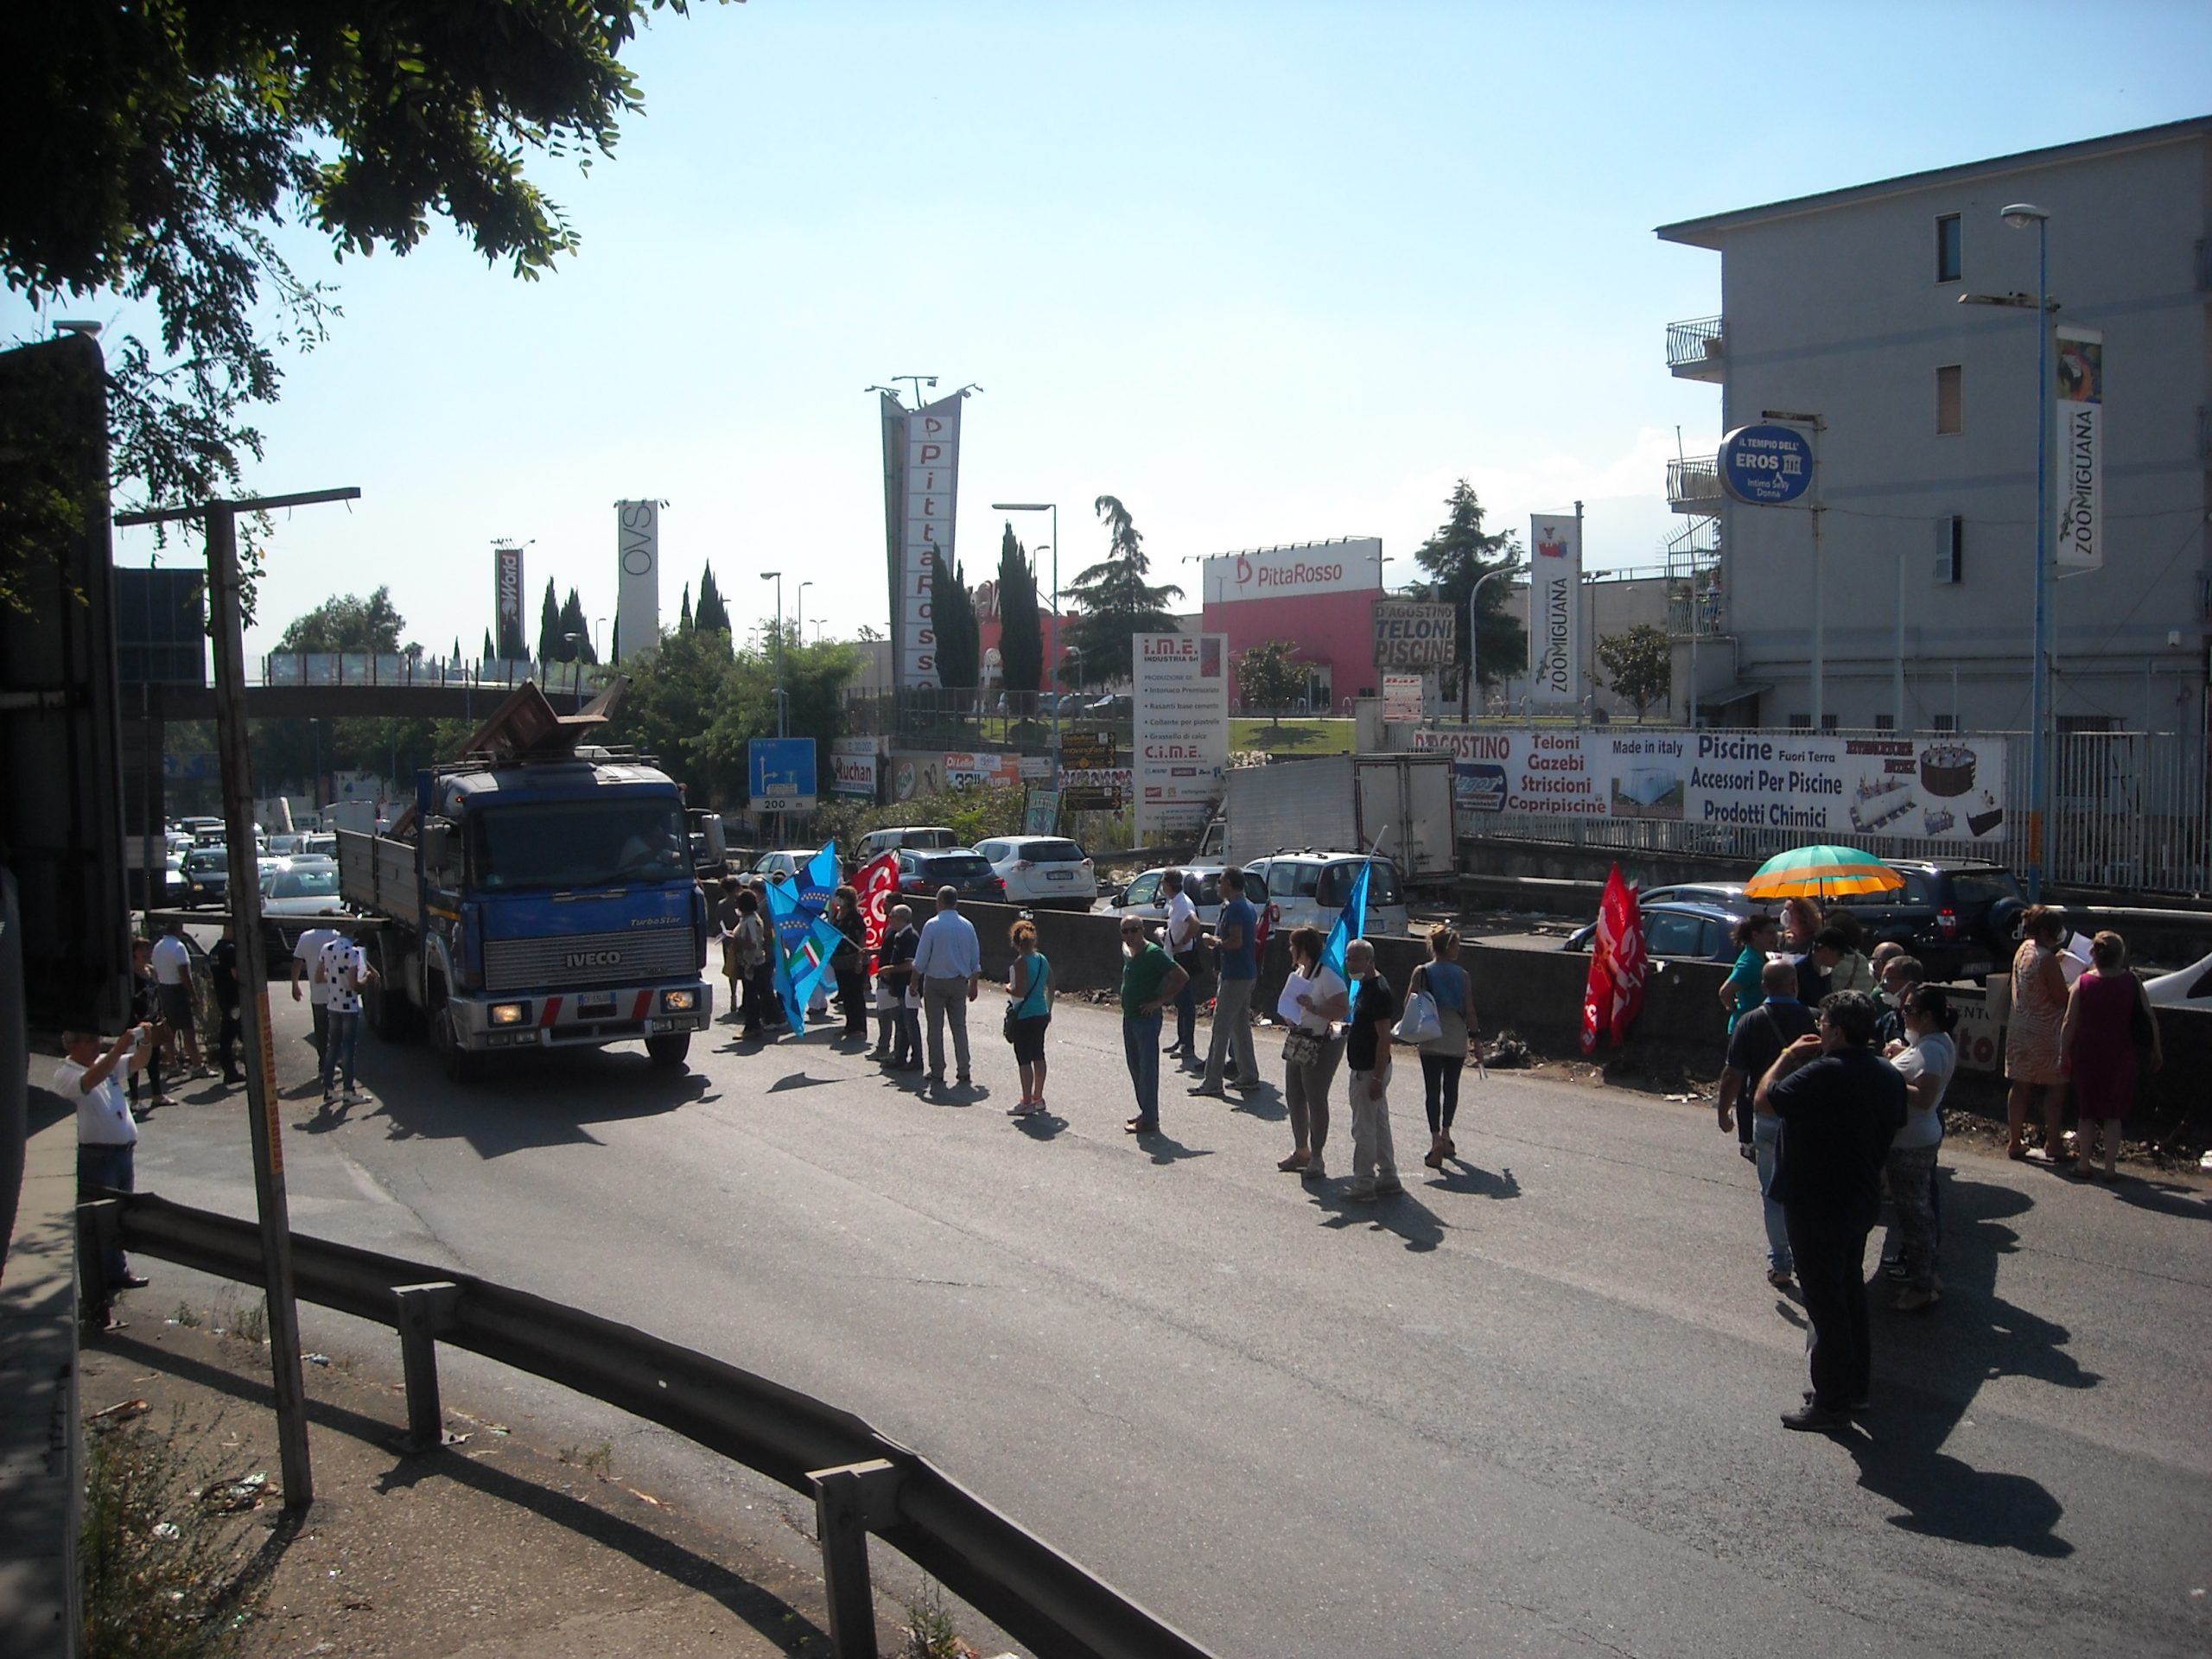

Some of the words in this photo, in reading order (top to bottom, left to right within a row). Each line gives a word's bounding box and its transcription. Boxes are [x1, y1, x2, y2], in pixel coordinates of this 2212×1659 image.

[1748, 439, 1777, 449] TEMPIO
[1736, 452, 1779, 469] EROS
[2076, 410, 2092, 554] ZOOMIGUANA
[623, 505, 652, 575] OVS
[1259, 563, 1342, 587] PittaRosso
[1376, 607, 1452, 618] D'AGOSTINO
[1376, 620, 1452, 639] TELONI
[1552, 577, 1567, 693] ZOOMIGUANA
[1376, 640, 1453, 664] PISCINE
[1532, 734, 1580, 750] Teloni
[1612, 741, 1641, 754] Made
[1645, 740, 1655, 754] in
[1658, 741, 1683, 758] italy
[1699, 735, 1773, 760] Piscine
[1779, 750, 1805, 763] Fuori
[1808, 751, 1836, 763] Terra
[836, 757, 871, 782] Auchan
[1528, 753, 1584, 771] Gazebi
[1522, 775, 1590, 793] Striscioni
[1691, 767, 1754, 790] Accessori
[1758, 770, 1784, 791] Per
[1789, 771, 1843, 795] Piscine
[764, 800, 786, 808] 200
[1509, 796, 1606, 814] Copripiscine
[1704, 800, 1765, 825] Prodotti
[1769, 804, 1827, 828] Chimici
[631, 916, 681, 926] TurboStar
[566, 951, 622, 967] IVECO
